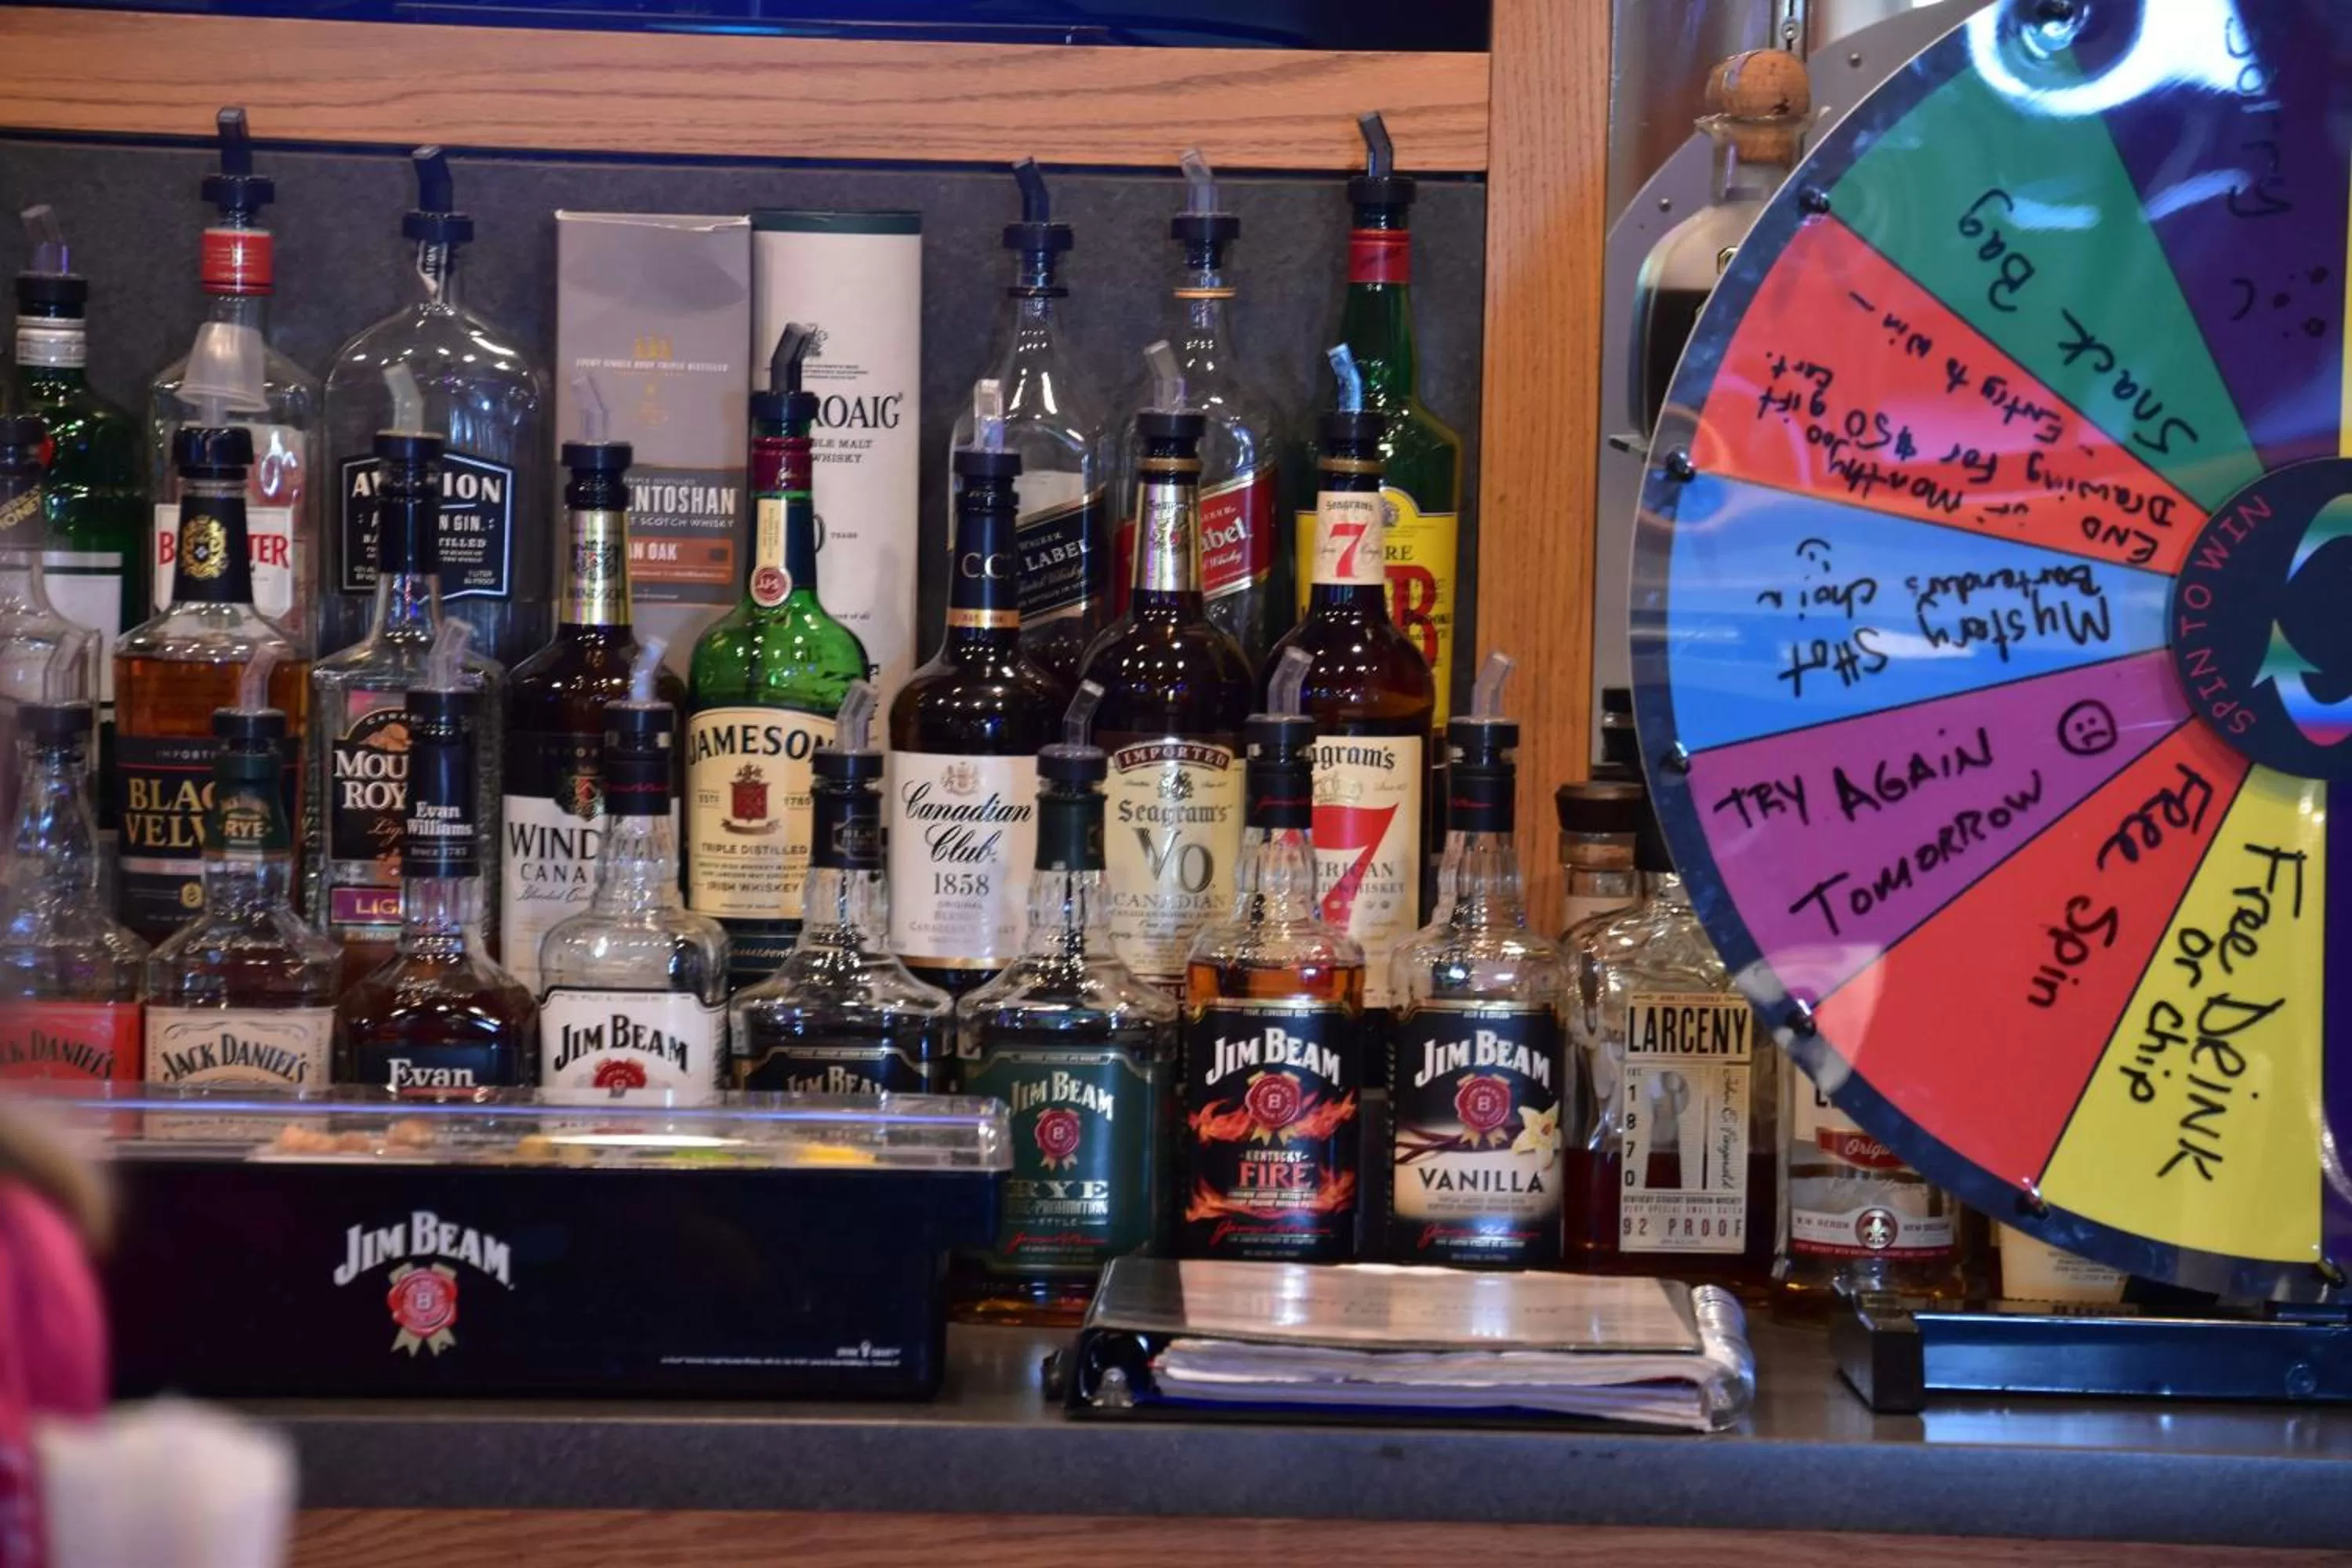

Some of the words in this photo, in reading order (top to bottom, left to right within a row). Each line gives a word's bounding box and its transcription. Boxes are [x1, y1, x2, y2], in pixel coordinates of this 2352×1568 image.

[1957, 188, 2034, 312] Bag
[2057, 307, 2200, 455] Snack
[627, 485, 736, 515] NTOSHAN
[2027, 452, 2177, 528] Drawing
[641, 517, 687, 527] SCOTCH
[690, 518, 735, 528] WHISKY
[1200, 517, 1247, 554] abel
[2195, 494, 2272, 572] WIN
[648, 542, 678, 561] OAK
[1330, 523, 1368, 579] 7
[1385, 545, 1414, 561] RE
[2180, 583, 2212, 638] TO
[2186, 647, 2257, 735] SPIN
[332, 749, 409, 781] MOU
[1123, 745, 1229, 768] IMPORTED
[1309, 745, 1396, 771] agram's
[341, 780, 408, 811] ROY
[1711, 773, 1810, 829] TRY
[1831, 726, 1994, 822] AGAIN
[415, 800, 462, 819] Evan
[902, 780, 1033, 823] Canadian
[1117, 799, 1231, 827] Seagram's
[407, 818, 474, 837] Williams
[509, 821, 602, 861] WIND
[924, 823, 1003, 863] Club
[702, 843, 738, 855] TRIPLE
[740, 845, 808, 856] DISTILLED
[520, 862, 588, 884] CANA
[933, 872, 991, 896] 1858
[354, 897, 402, 916] LIG
[2219, 842, 2308, 975] Free
[554, 1023, 604, 1073] JIM
[609, 1014, 689, 1073] BEAM
[1628, 1006, 1748, 1054] LARCENY
[162, 1042, 218, 1083] JACK
[220, 1033, 310, 1084] DANIEL'S
[387, 1058, 477, 1087] Evan
[1205, 1036, 1261, 1087] JIM
[1265, 1026, 1341, 1087] BEAM
[1414, 1038, 1472, 1089] JIM
[1474, 1029, 1551, 1088] BEAM
[1006, 1078, 1047, 1116] JIM
[1051, 1069, 1115, 1122] BEAM
[1239, 1162, 1315, 1188] FIRE
[1418, 1167, 1545, 1193] VANILLA
[1623, 1218, 1648, 1236] 92
[1668, 1218, 1743, 1238] PROOF
[333, 1222, 407, 1287] JIM
[410, 1210, 512, 1287] BEAM
